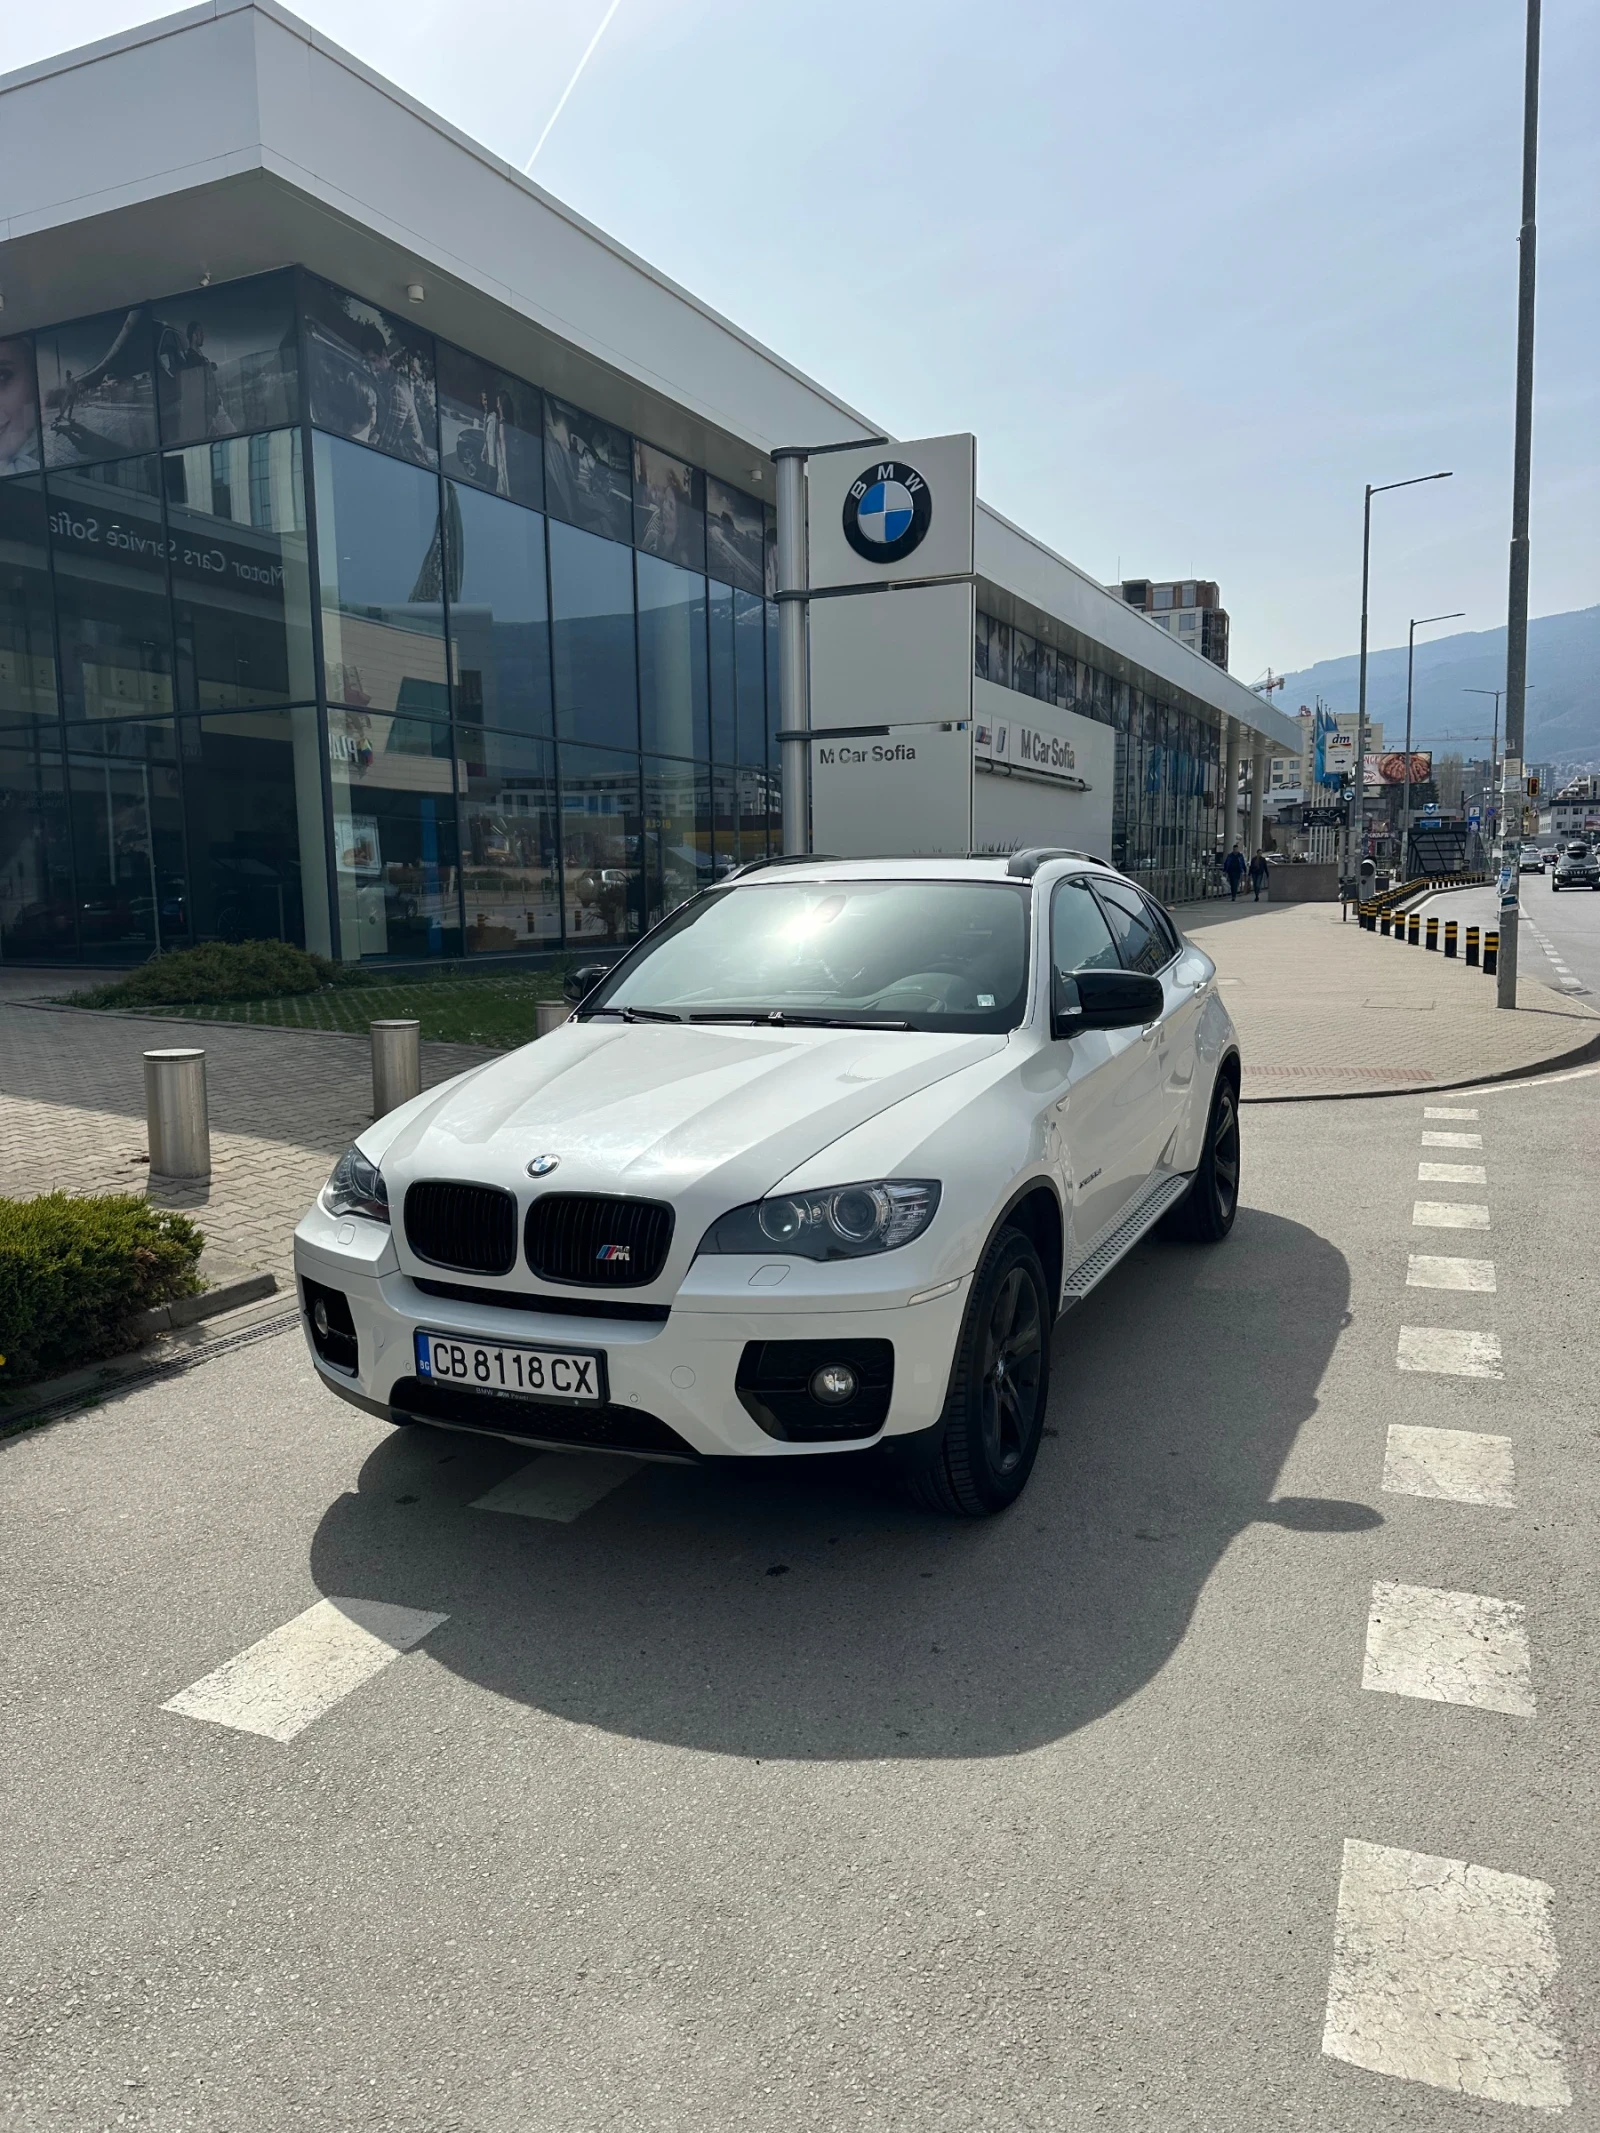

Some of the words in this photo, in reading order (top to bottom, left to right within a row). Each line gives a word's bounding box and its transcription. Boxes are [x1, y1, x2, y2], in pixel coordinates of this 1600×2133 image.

[851, 464, 924, 500] BMW
[1332, 733, 1350, 743] dm
[820, 748, 834, 764] M
[838, 748, 867, 764] Car
[872, 744, 916, 762] Sofia
[1021, 729, 1031, 759] M
[1033, 732, 1051, 764] Car
[1052, 737, 1075, 770] Sofia
[420, 1359, 430, 1371] BG
[475, 1387, 494, 1396] BMW
